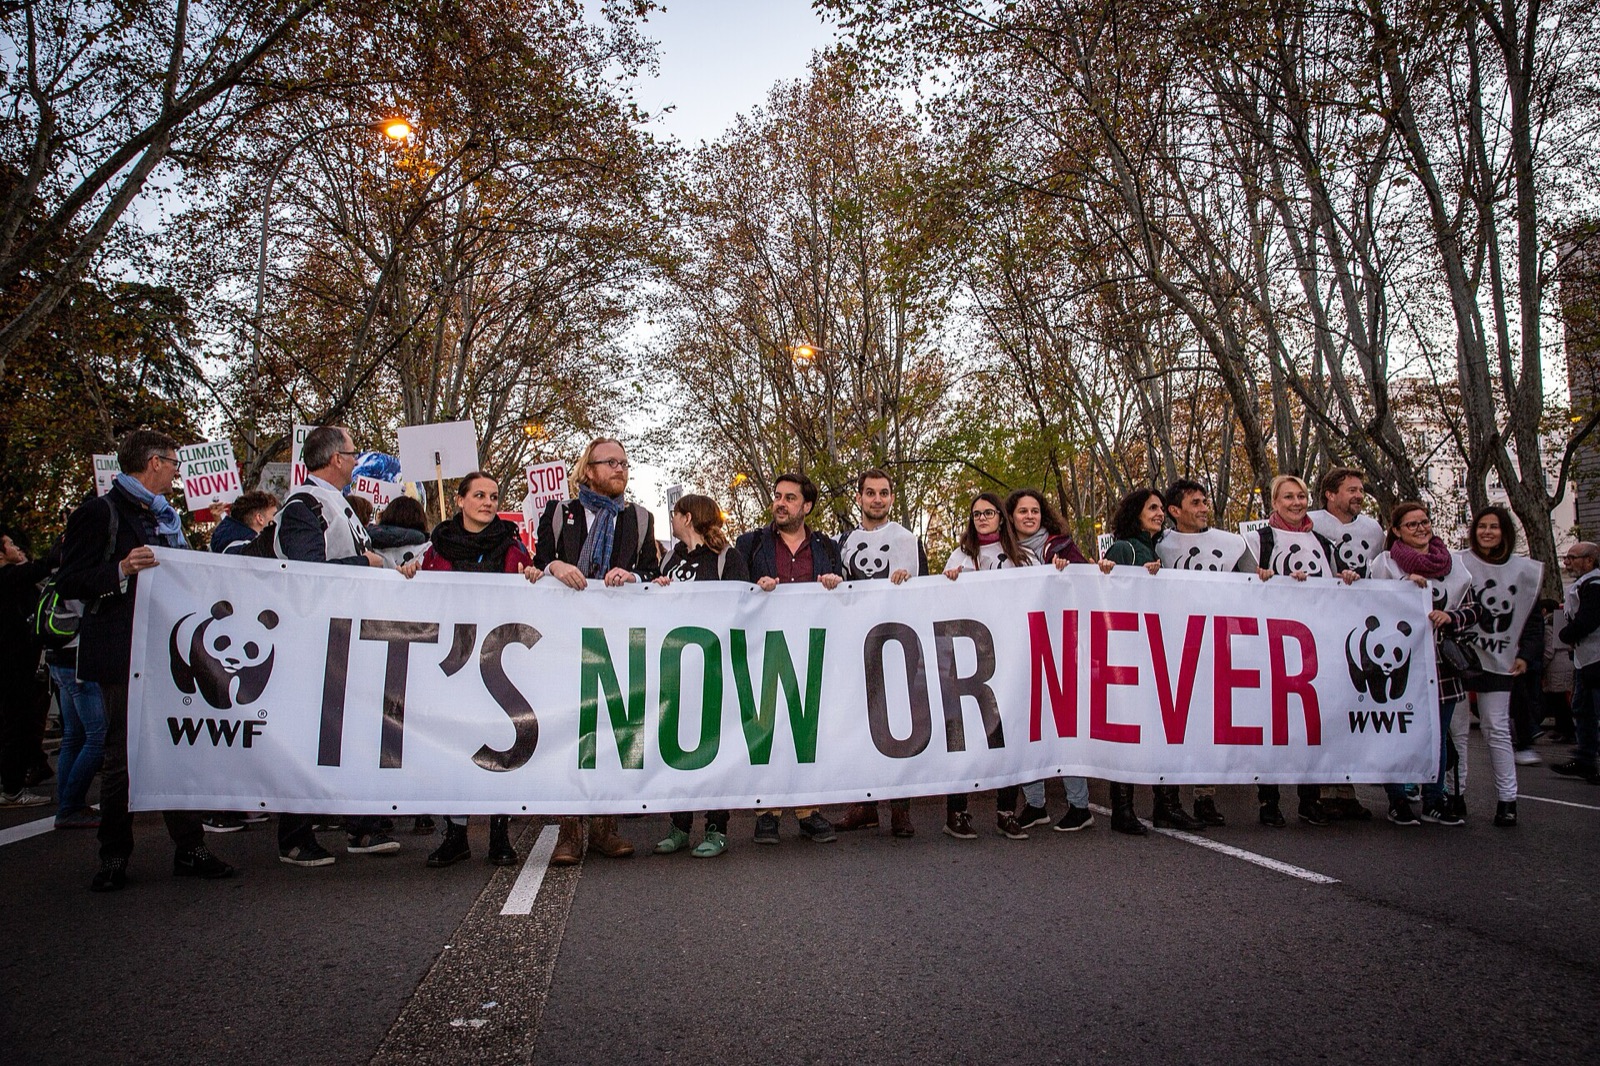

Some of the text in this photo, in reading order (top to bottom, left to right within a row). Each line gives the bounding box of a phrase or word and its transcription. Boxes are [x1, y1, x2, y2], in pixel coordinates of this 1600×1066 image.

[179, 443, 229, 462] CLIMATE
[188, 458, 229, 476] ACTION
[186, 472, 238, 498] NOW!
[358, 479, 379, 496] BLA
[529, 466, 564, 495] STOP
[374, 495, 389, 505] BLA
[317, 610, 1321, 772] IT'S NOW OR NEVER
[167, 717, 268, 748] WWF
[1349, 711, 1414, 733] WWF
